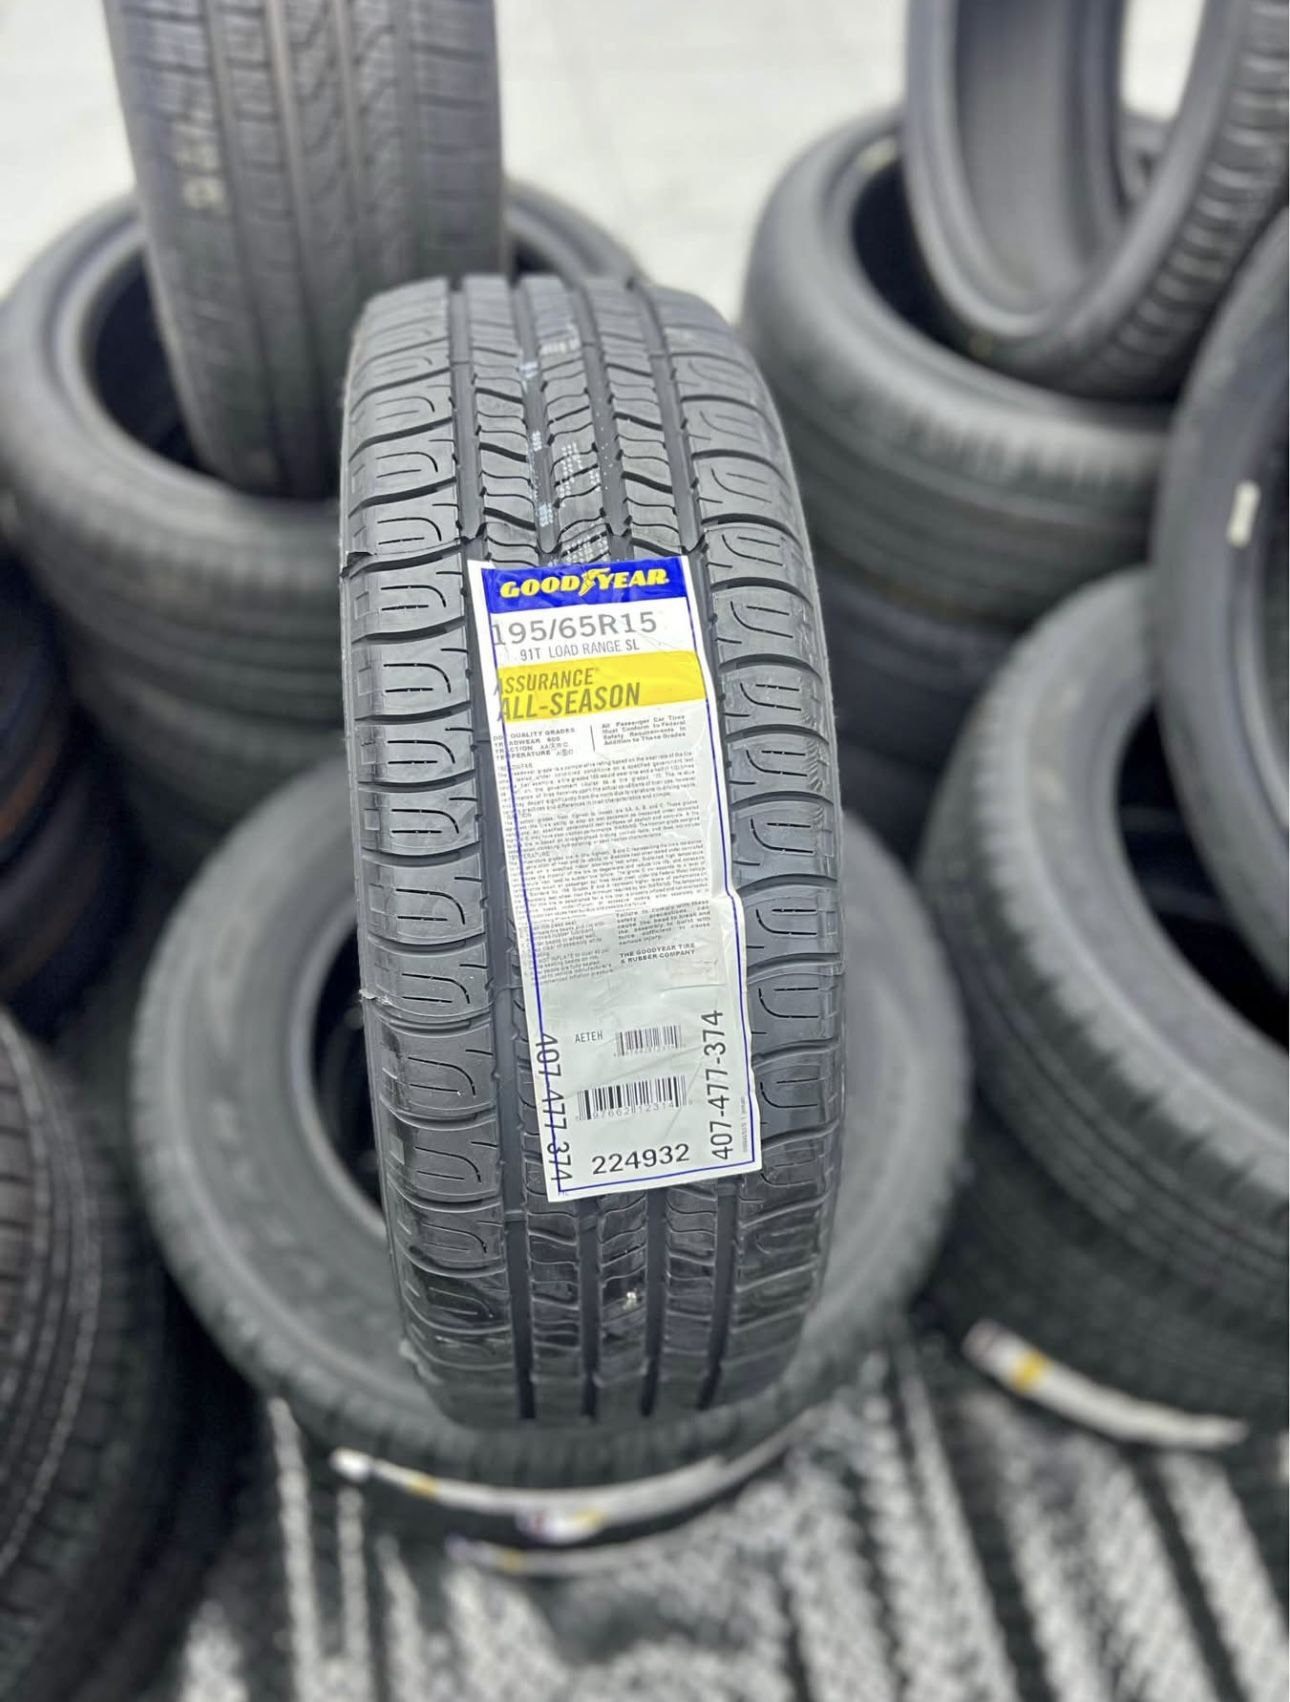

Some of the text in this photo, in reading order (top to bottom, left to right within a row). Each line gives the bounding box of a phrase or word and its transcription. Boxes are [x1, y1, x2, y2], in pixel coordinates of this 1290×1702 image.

[499, 568, 669, 598] GOODYEAR
[492, 611, 657, 646] 195/65R15
[520, 638, 640, 661] 91T LOAD RANGE SL
[496, 682, 641, 722] ALL-SEASON
[510, 730, 542, 739] QUALITY
[636, 945, 677, 955] GOODYEAR
[659, 950, 696, 958] COMPANY
[701, 1010, 733, 1161] 407-477-374
[591, 1143, 690, 1175] 224932
